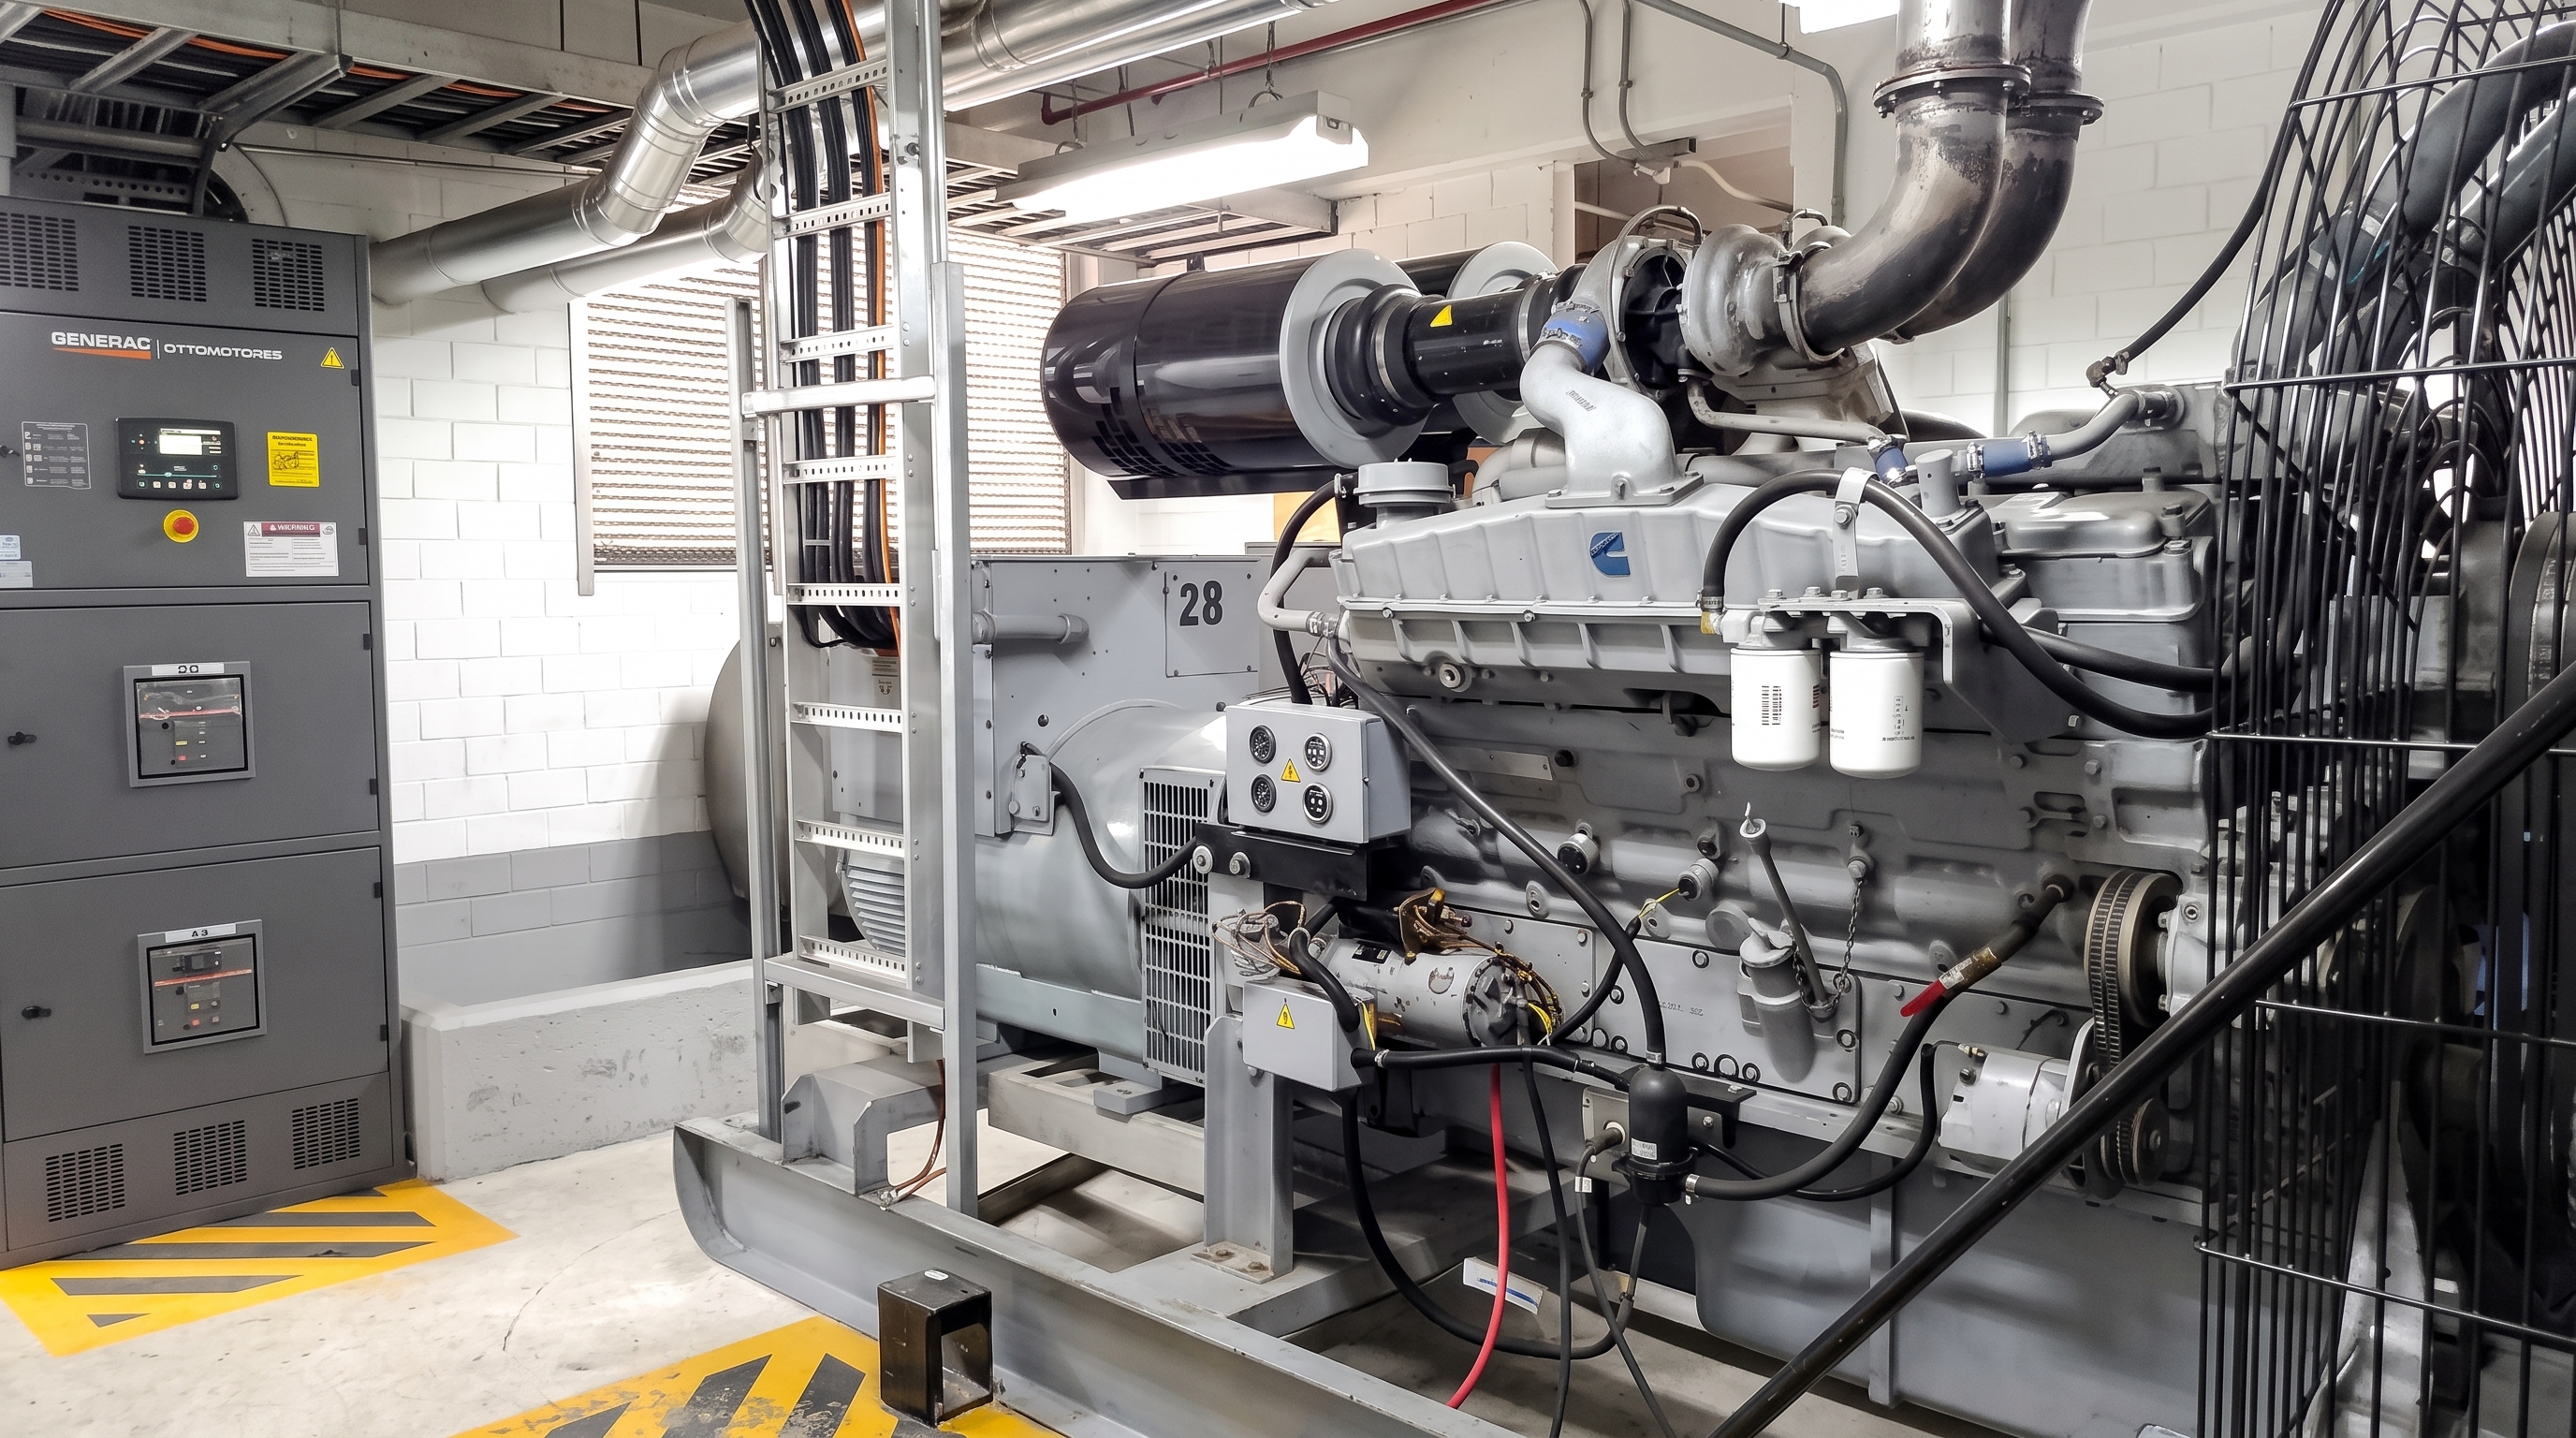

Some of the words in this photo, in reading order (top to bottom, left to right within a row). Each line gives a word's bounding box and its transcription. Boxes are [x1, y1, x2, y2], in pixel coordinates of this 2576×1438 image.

[51, 331, 151, 350] GENERAC
[164, 343, 283, 360] OTTOMOTORES
[1179, 580, 1223, 626] 28
